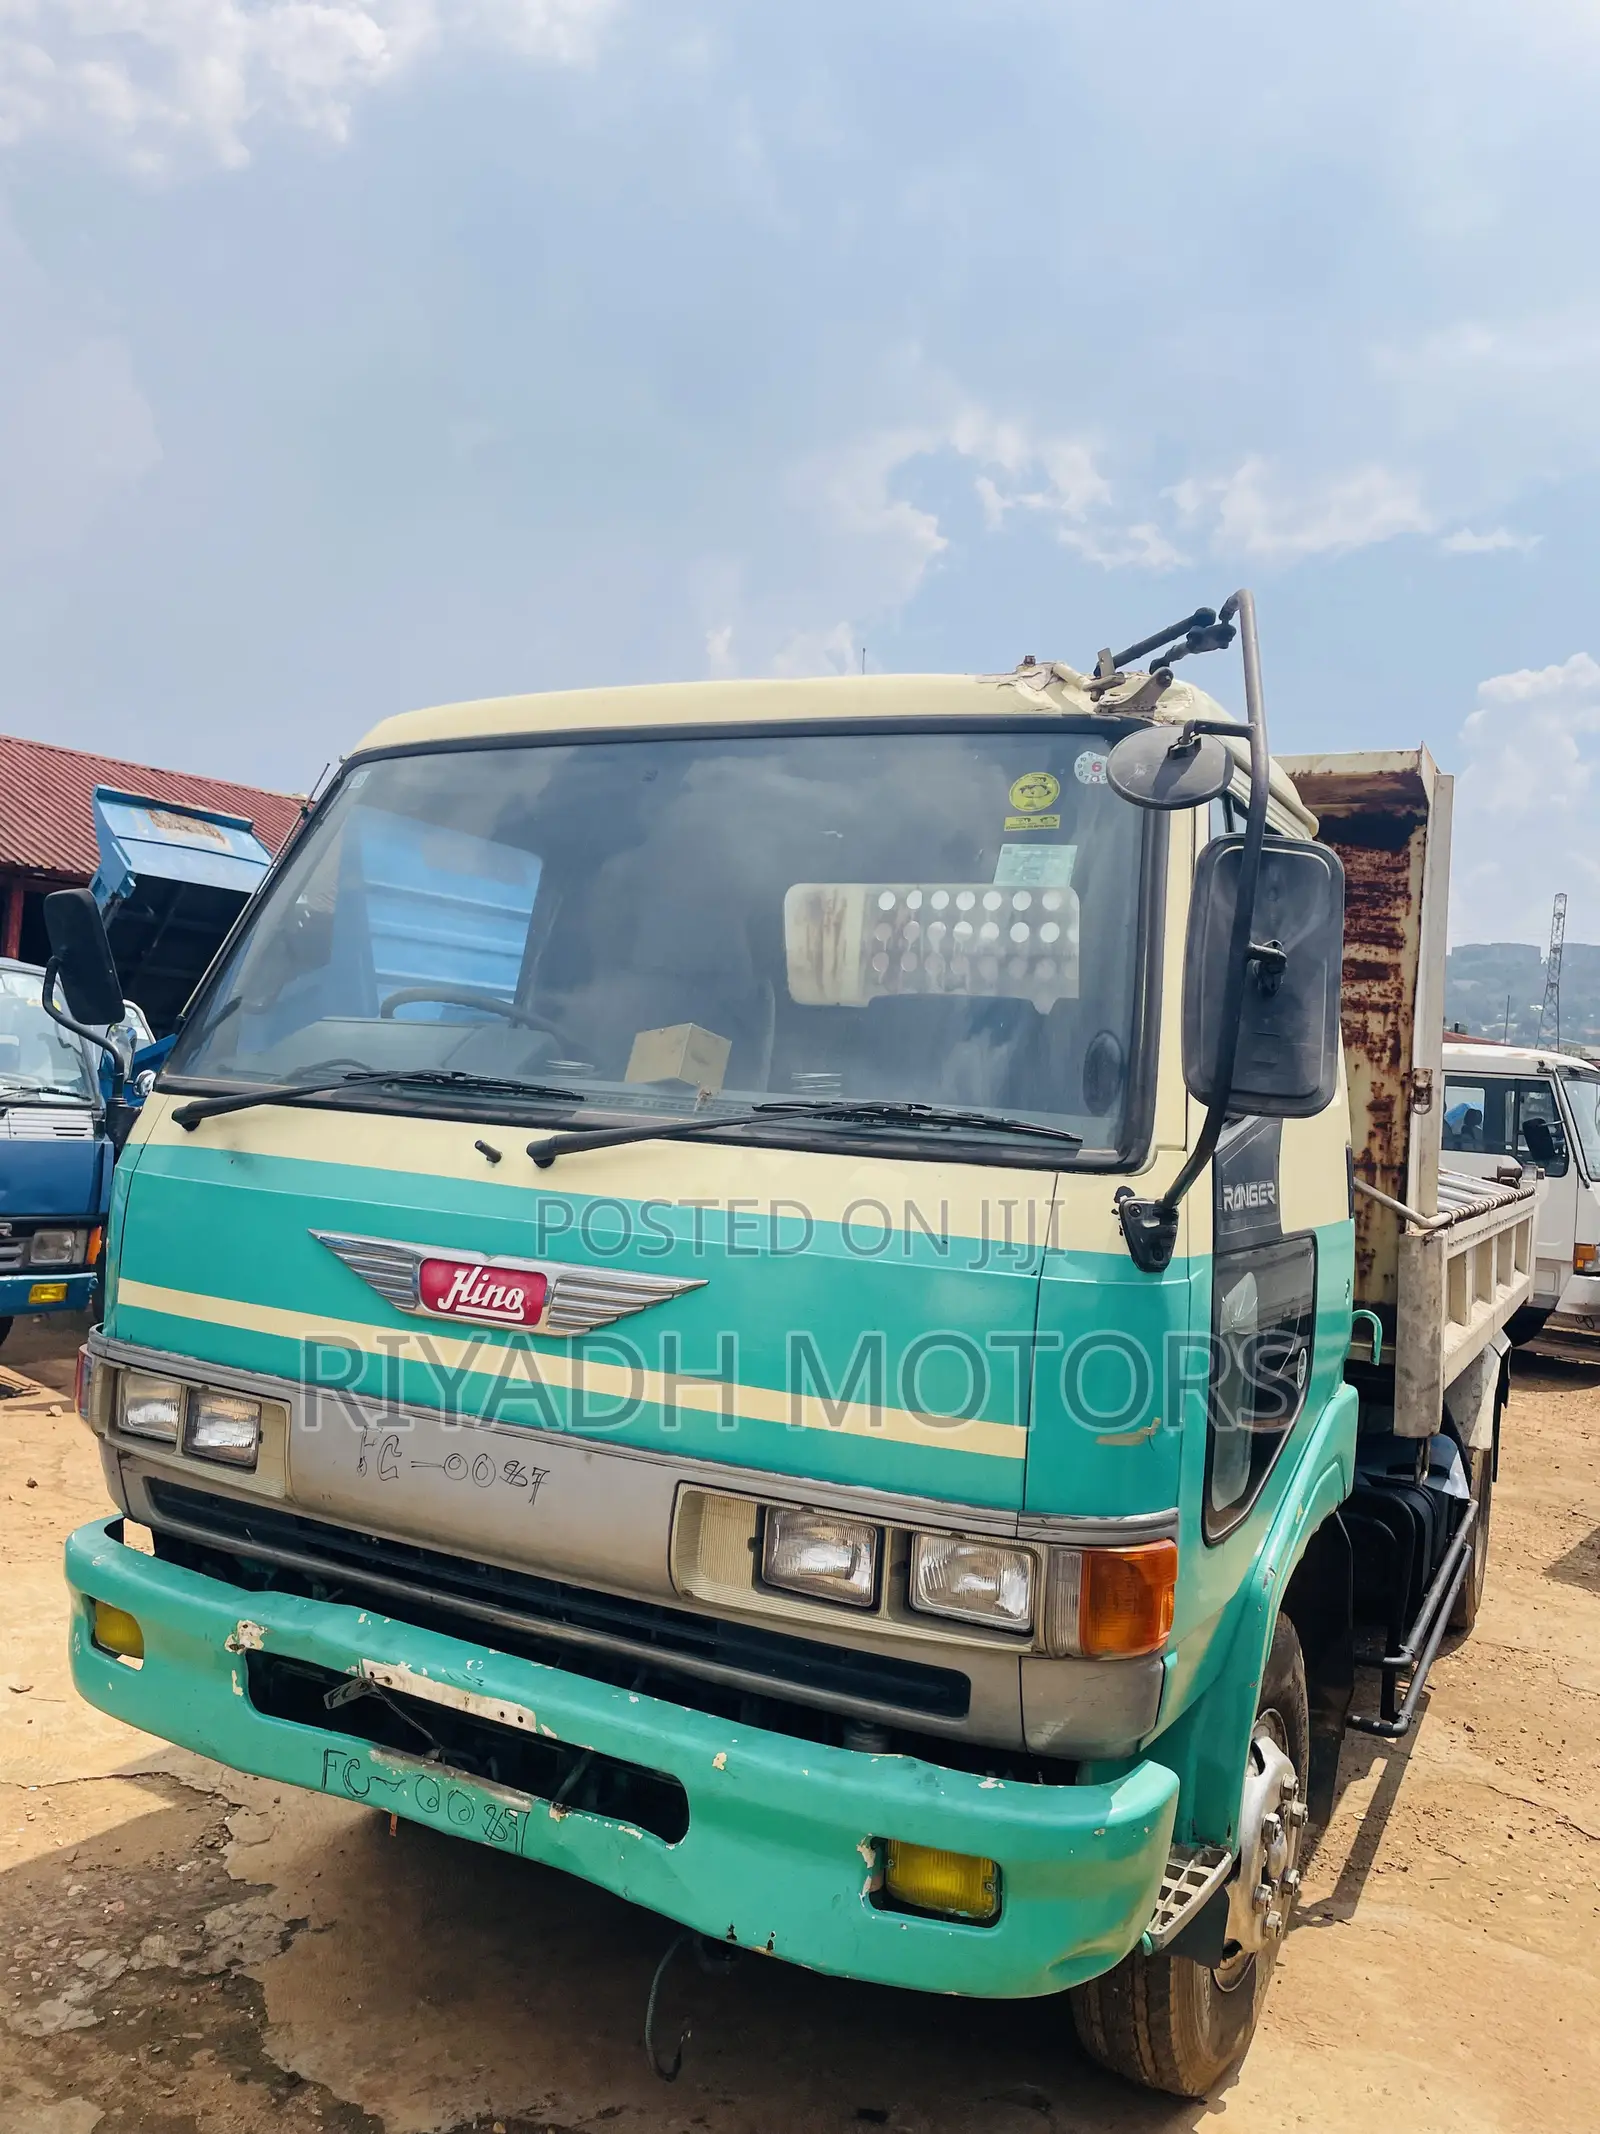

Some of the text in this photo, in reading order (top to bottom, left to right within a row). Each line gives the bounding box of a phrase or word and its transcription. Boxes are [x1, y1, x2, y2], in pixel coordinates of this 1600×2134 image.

[1091, 761, 1102, 773] 6
[1222, 1180, 1277, 1213] RANGER
[437, 1266, 525, 1321] Hino
